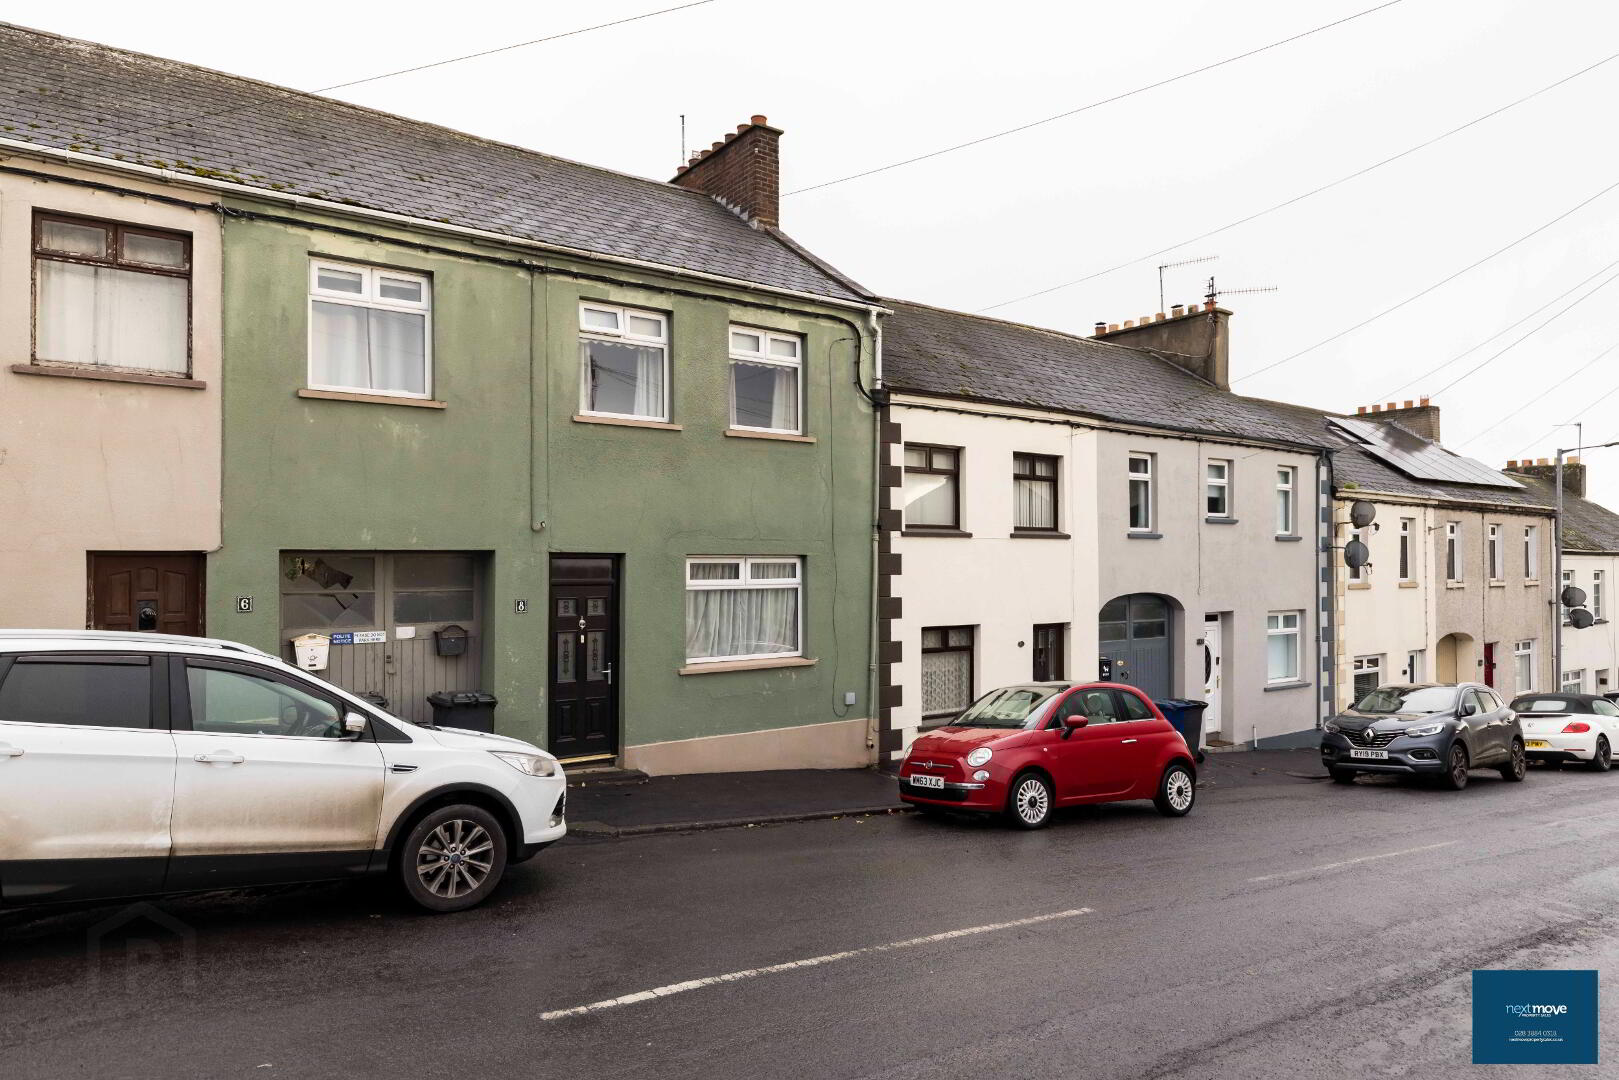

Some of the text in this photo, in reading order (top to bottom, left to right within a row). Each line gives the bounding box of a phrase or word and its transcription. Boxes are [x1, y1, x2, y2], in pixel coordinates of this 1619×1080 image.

[241, 598, 249, 610] 6
[518, 601, 525, 611] 8
[928, 777, 941, 788] XJC
